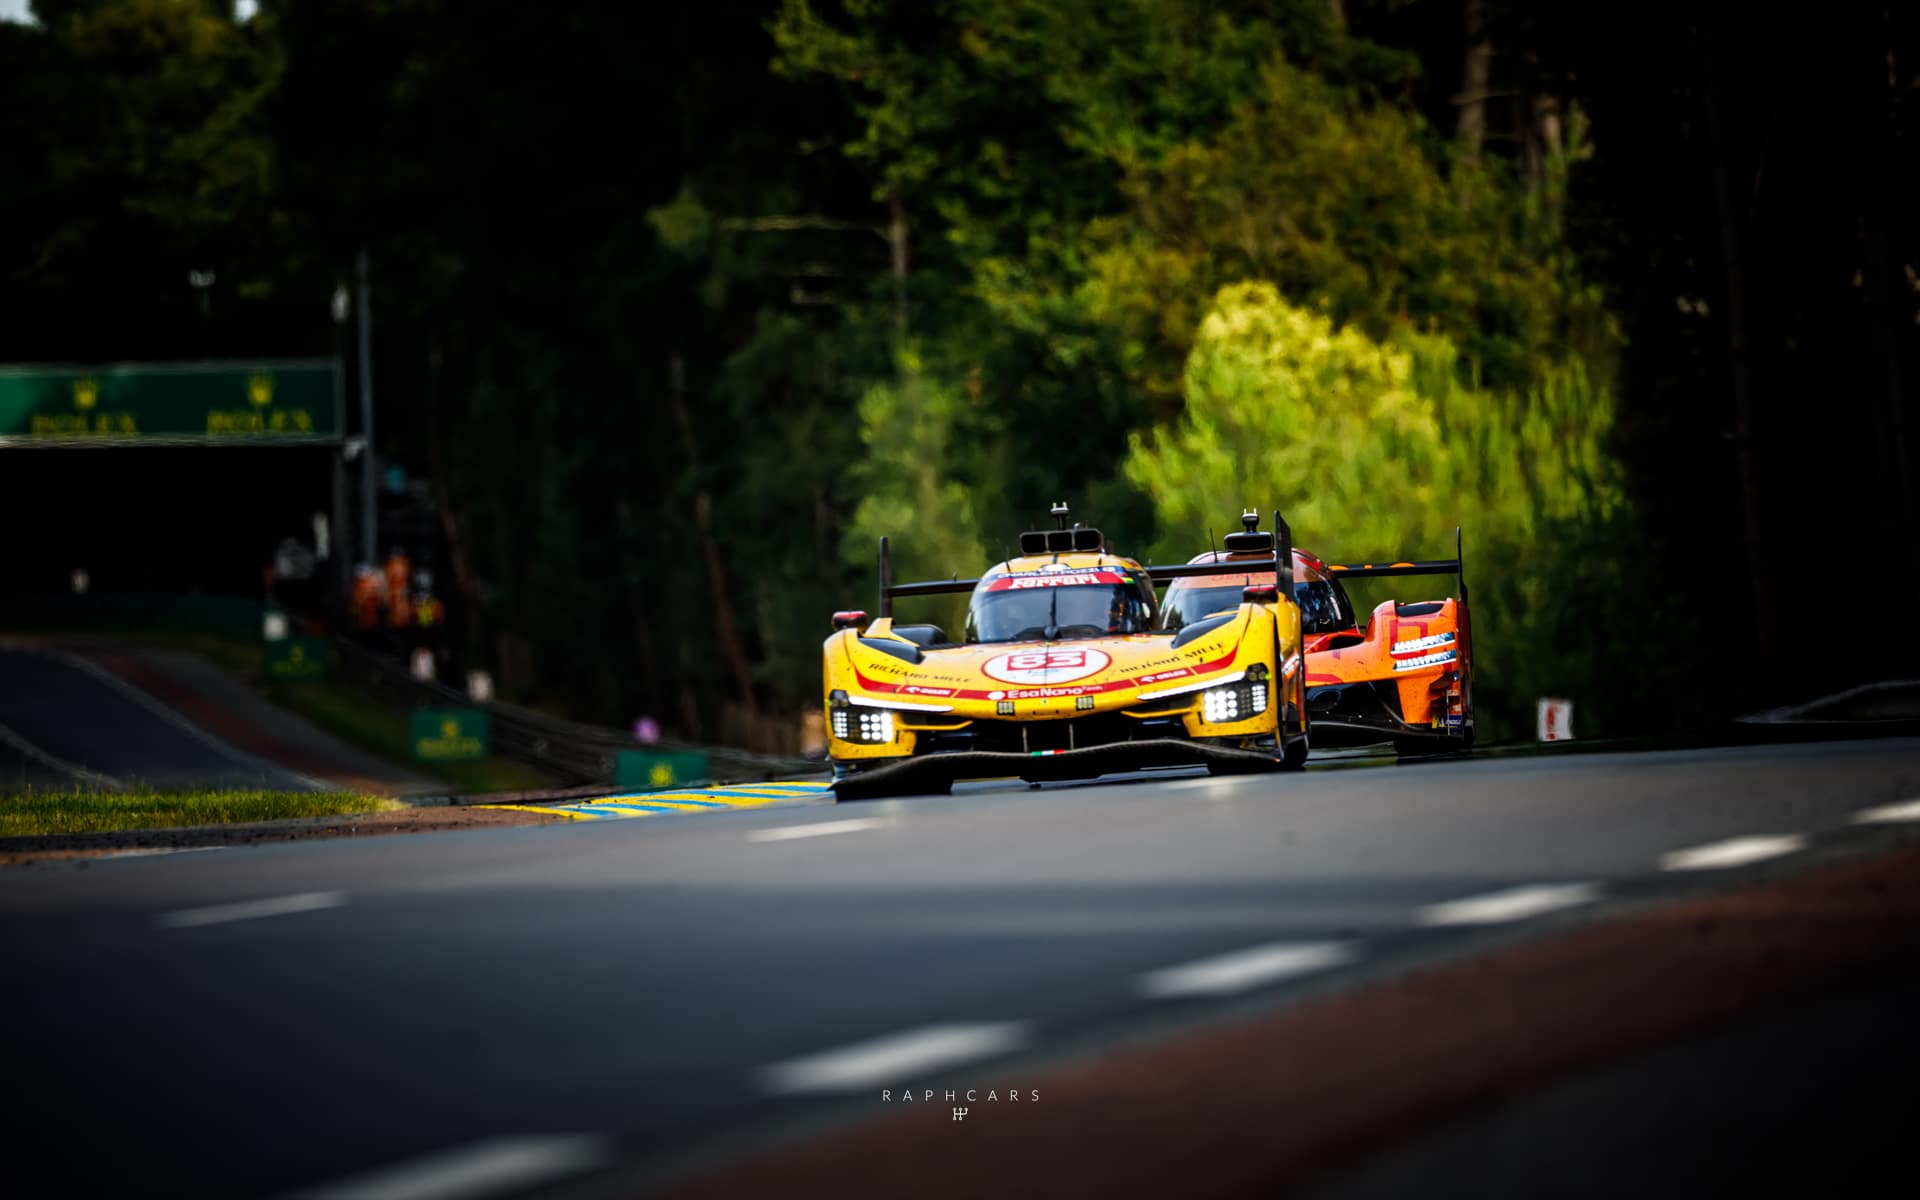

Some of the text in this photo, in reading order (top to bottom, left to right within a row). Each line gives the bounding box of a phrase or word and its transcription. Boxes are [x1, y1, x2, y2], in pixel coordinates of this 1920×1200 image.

[207, 410, 313, 435] ROLEX
[1008, 574, 1100, 589] Ferrari
[1010, 653, 1084, 669] 83
[868, 663, 928, 679] RICHARD
